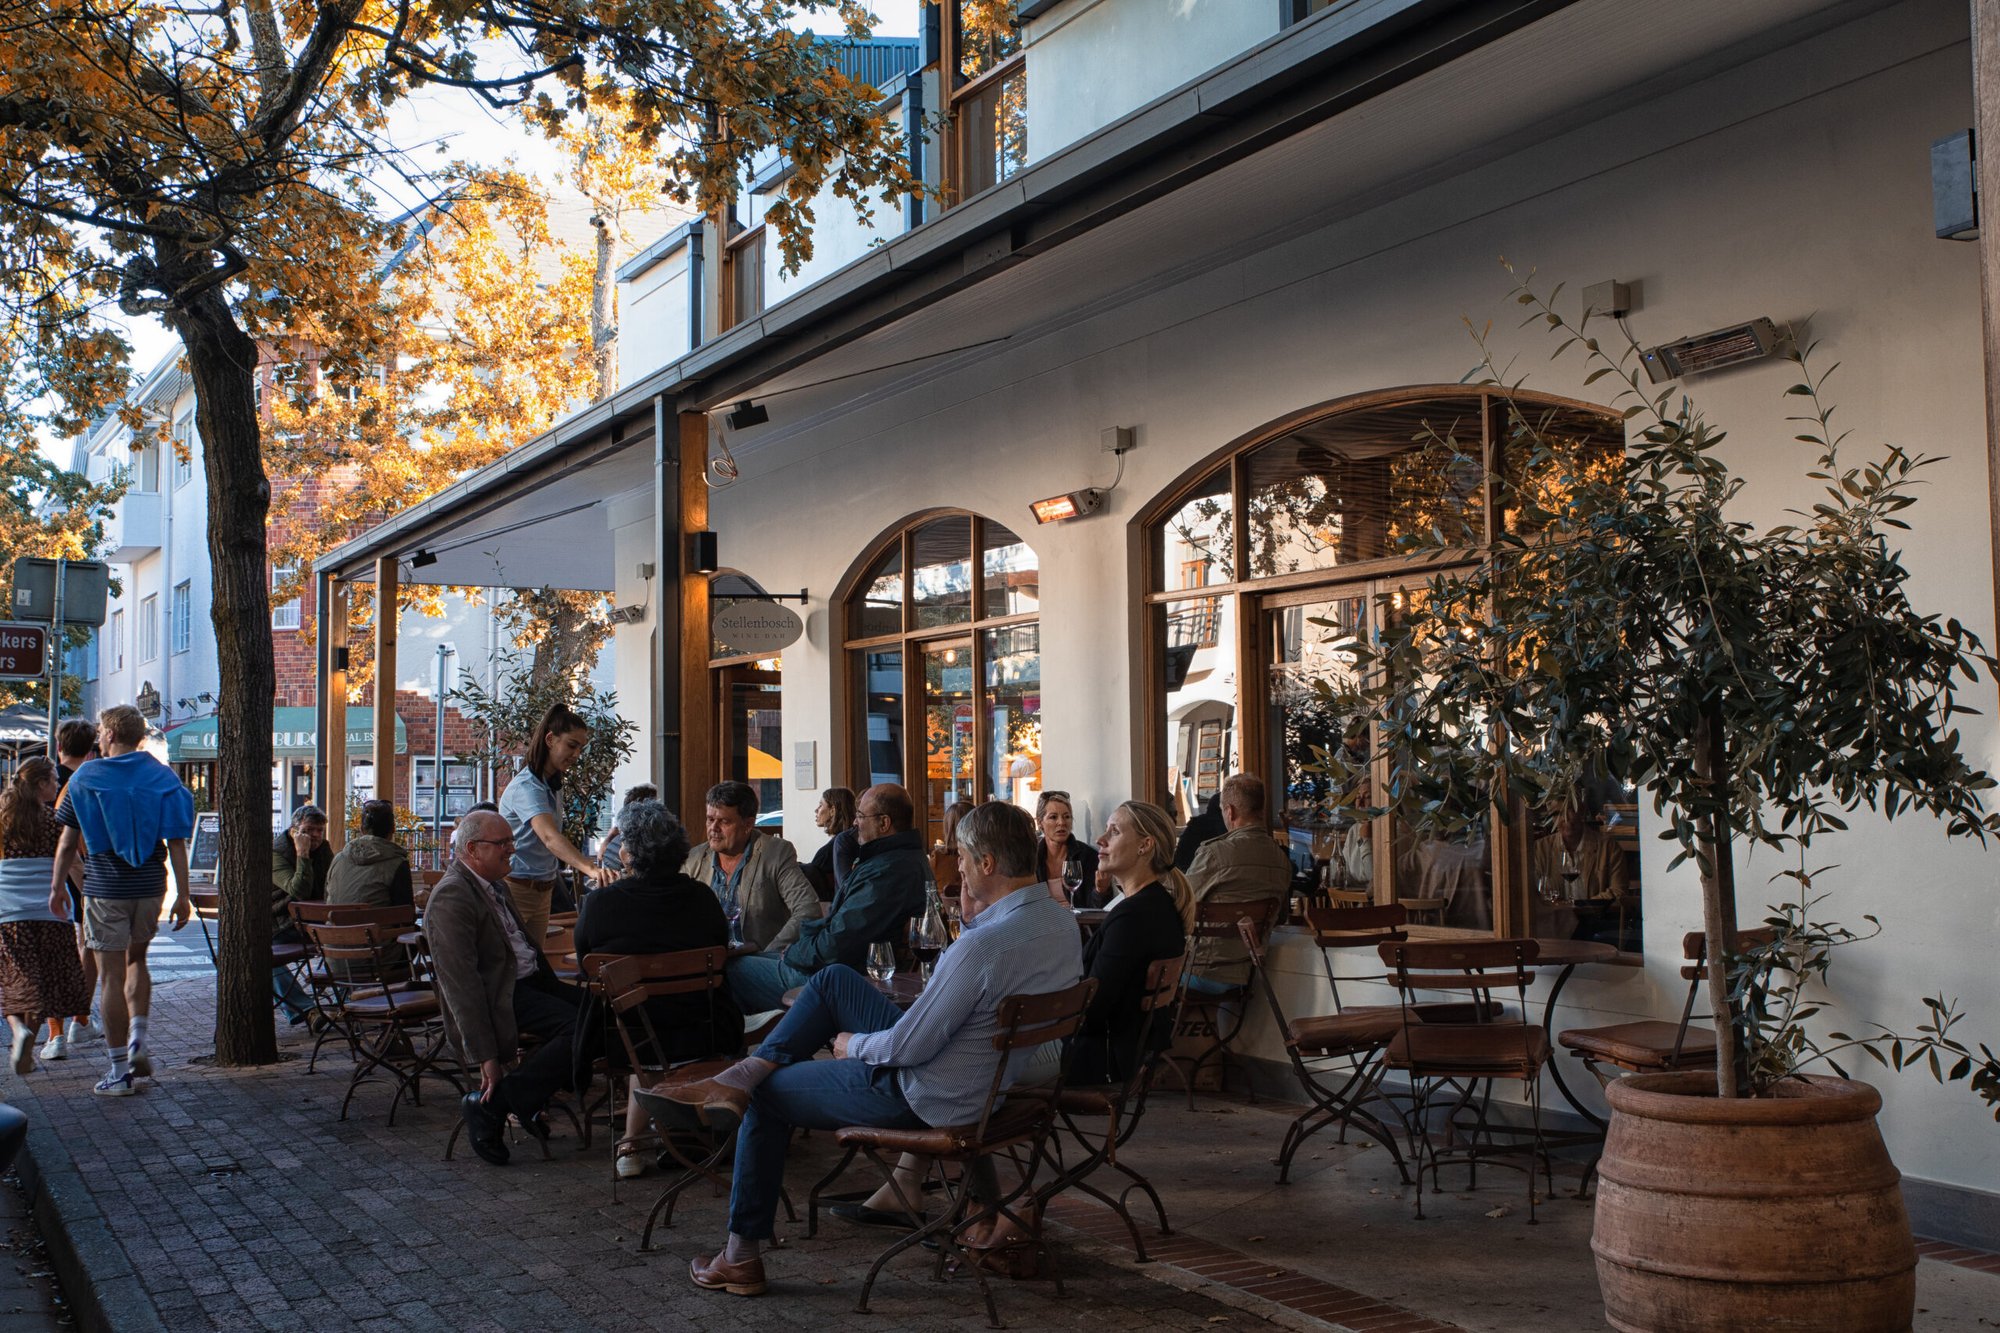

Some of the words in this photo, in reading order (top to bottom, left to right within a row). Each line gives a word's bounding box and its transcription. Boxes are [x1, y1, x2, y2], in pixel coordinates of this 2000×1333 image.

[721, 616, 794, 629] Stellenbosch
[0, 631, 37, 649] kers
[345, 732, 361, 742] EAL
